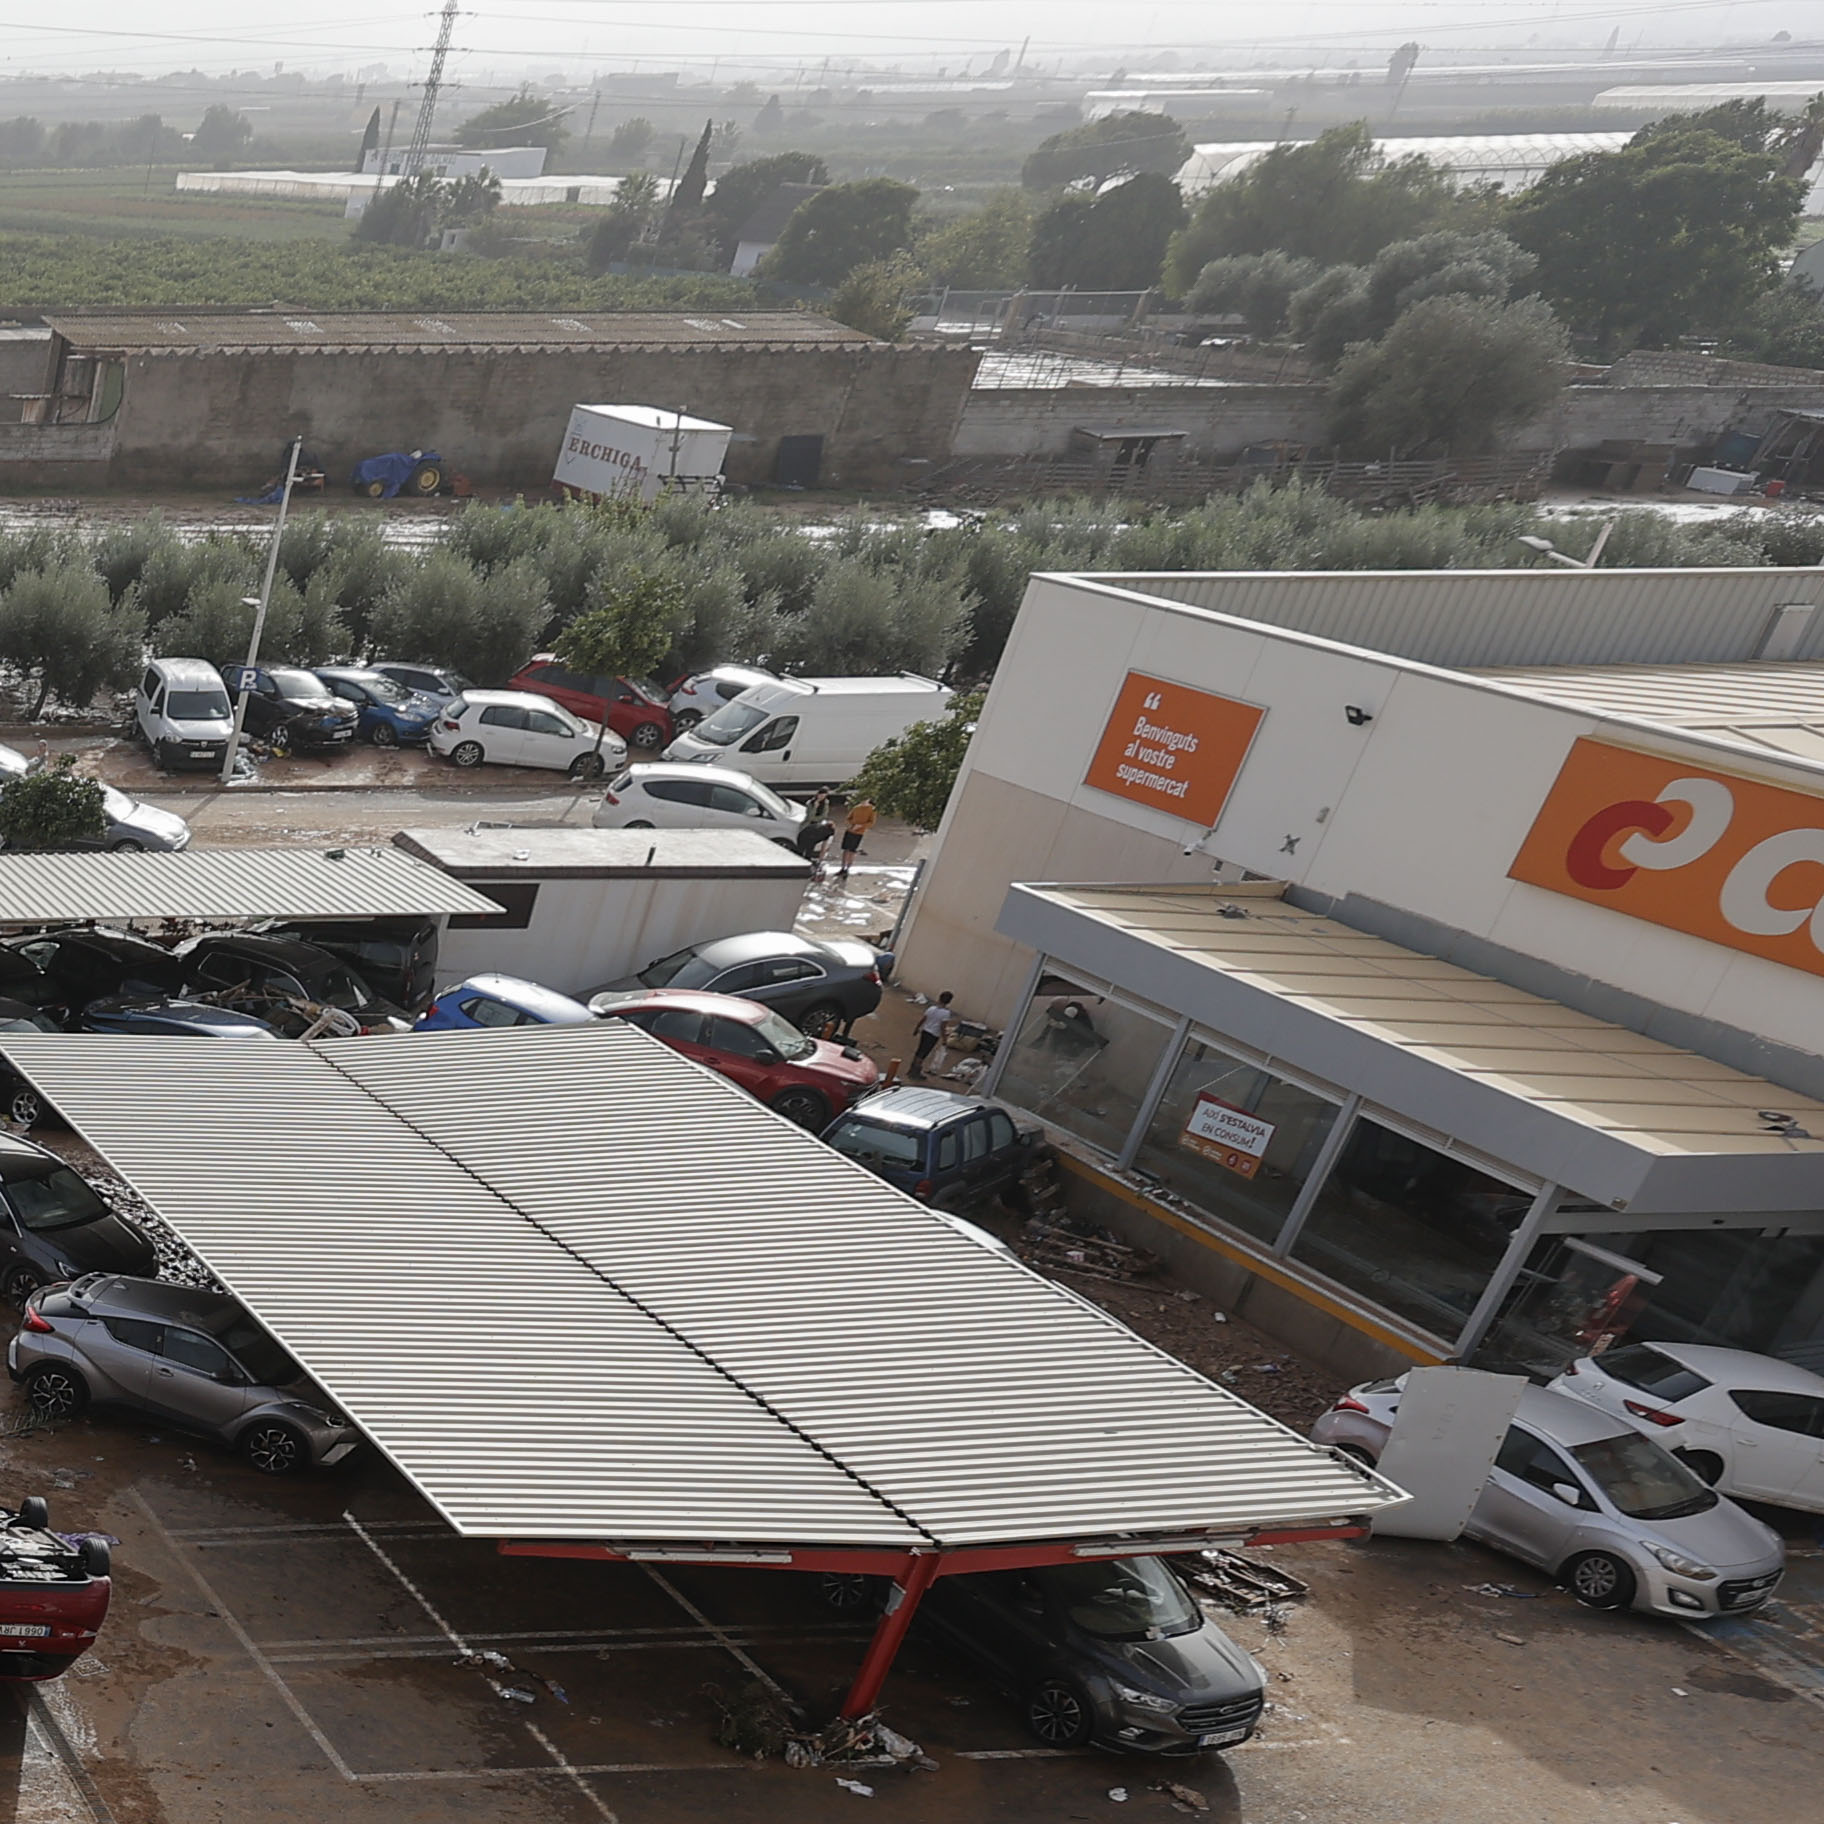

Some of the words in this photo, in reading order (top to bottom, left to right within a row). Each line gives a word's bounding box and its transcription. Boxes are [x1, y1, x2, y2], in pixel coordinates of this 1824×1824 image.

[1133, 717, 1199, 753] Benvinguts
[1124, 740, 1136, 758] al
[1138, 746, 1175, 770] vostre
[1116, 765, 1190, 798] supermercat
[1203, 1123, 1213, 1134] EN
[1215, 1127, 1257, 1150] CONSUM!
[1219, 1113, 1266, 1137] S'ESTALVIA
[18, 1625, 43, 1635] 0661
